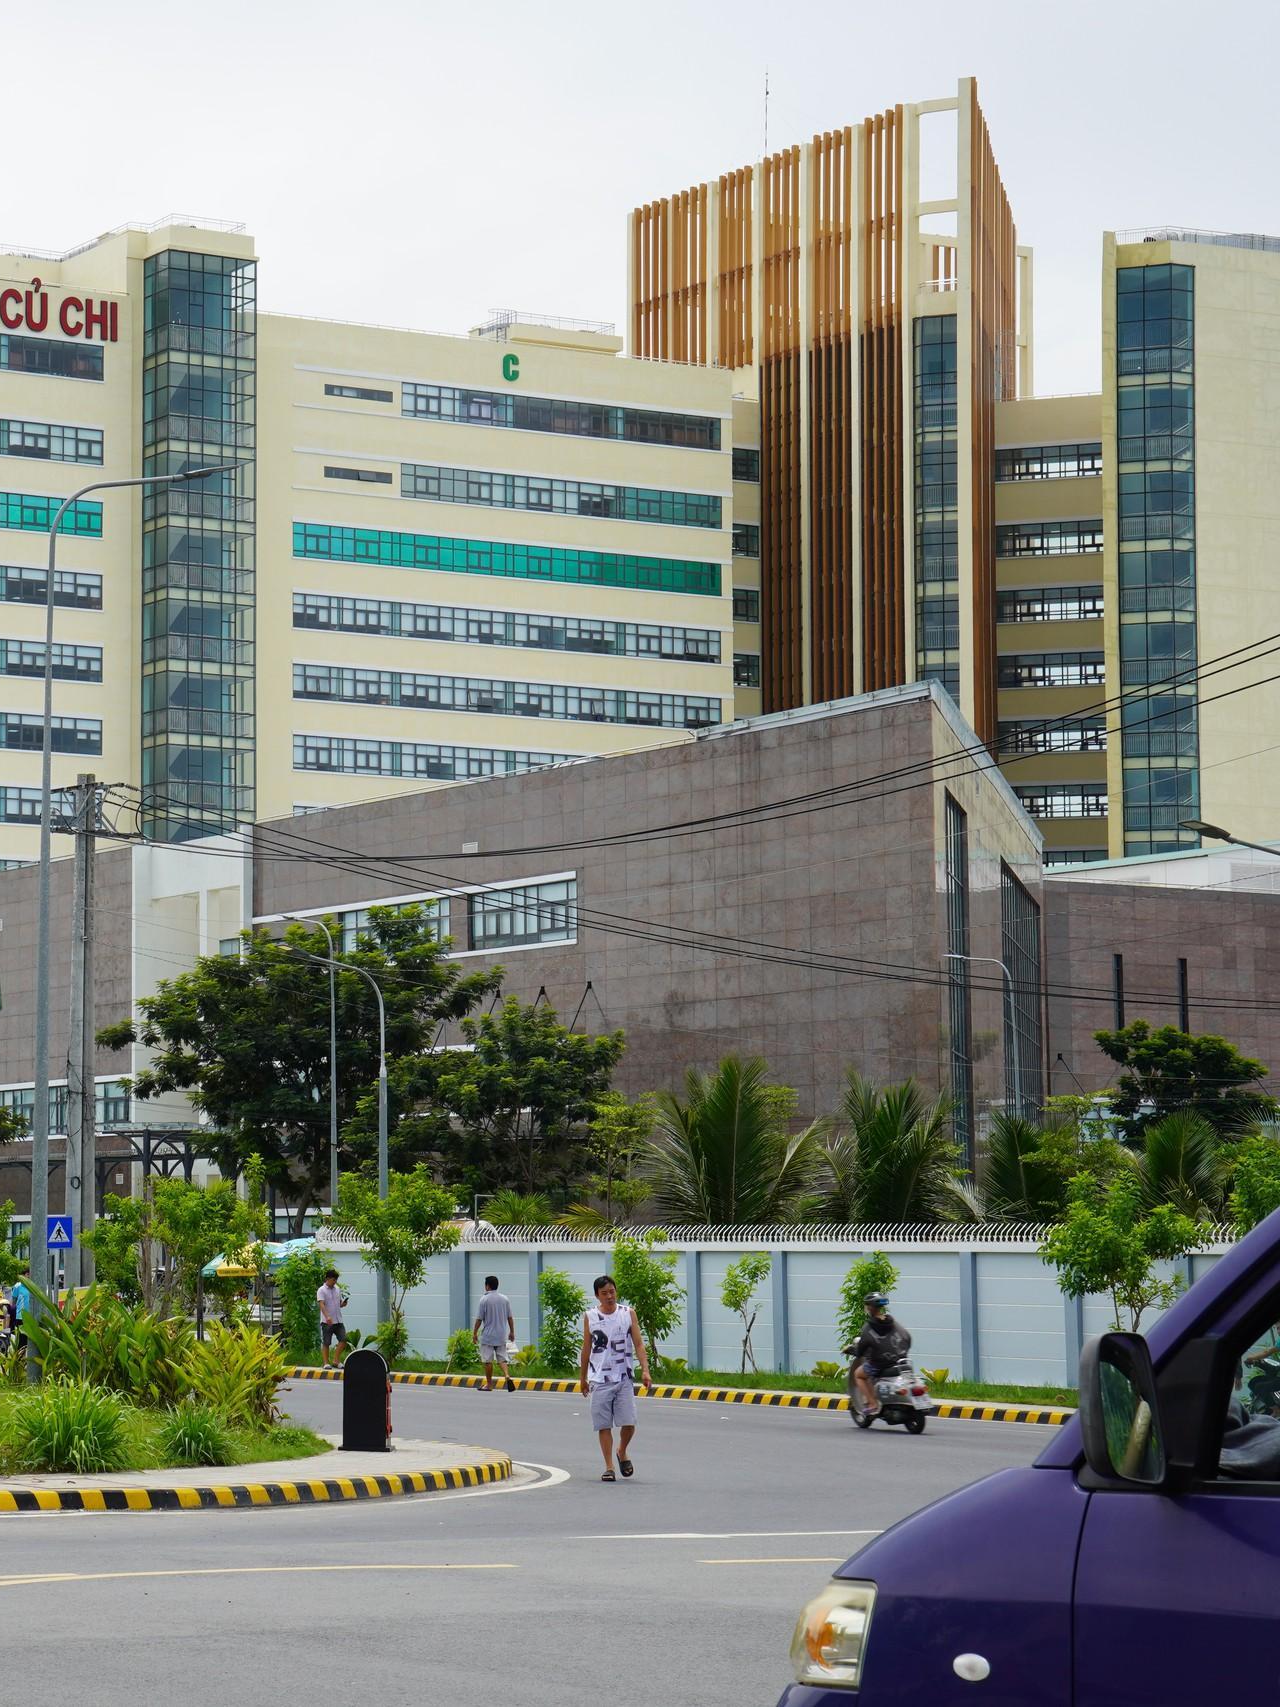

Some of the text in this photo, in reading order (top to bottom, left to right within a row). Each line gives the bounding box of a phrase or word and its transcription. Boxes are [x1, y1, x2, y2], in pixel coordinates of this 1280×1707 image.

[0, 277, 48, 332] CỦ
[60, 297, 118, 342] CHI
[503, 353, 519, 382] C
